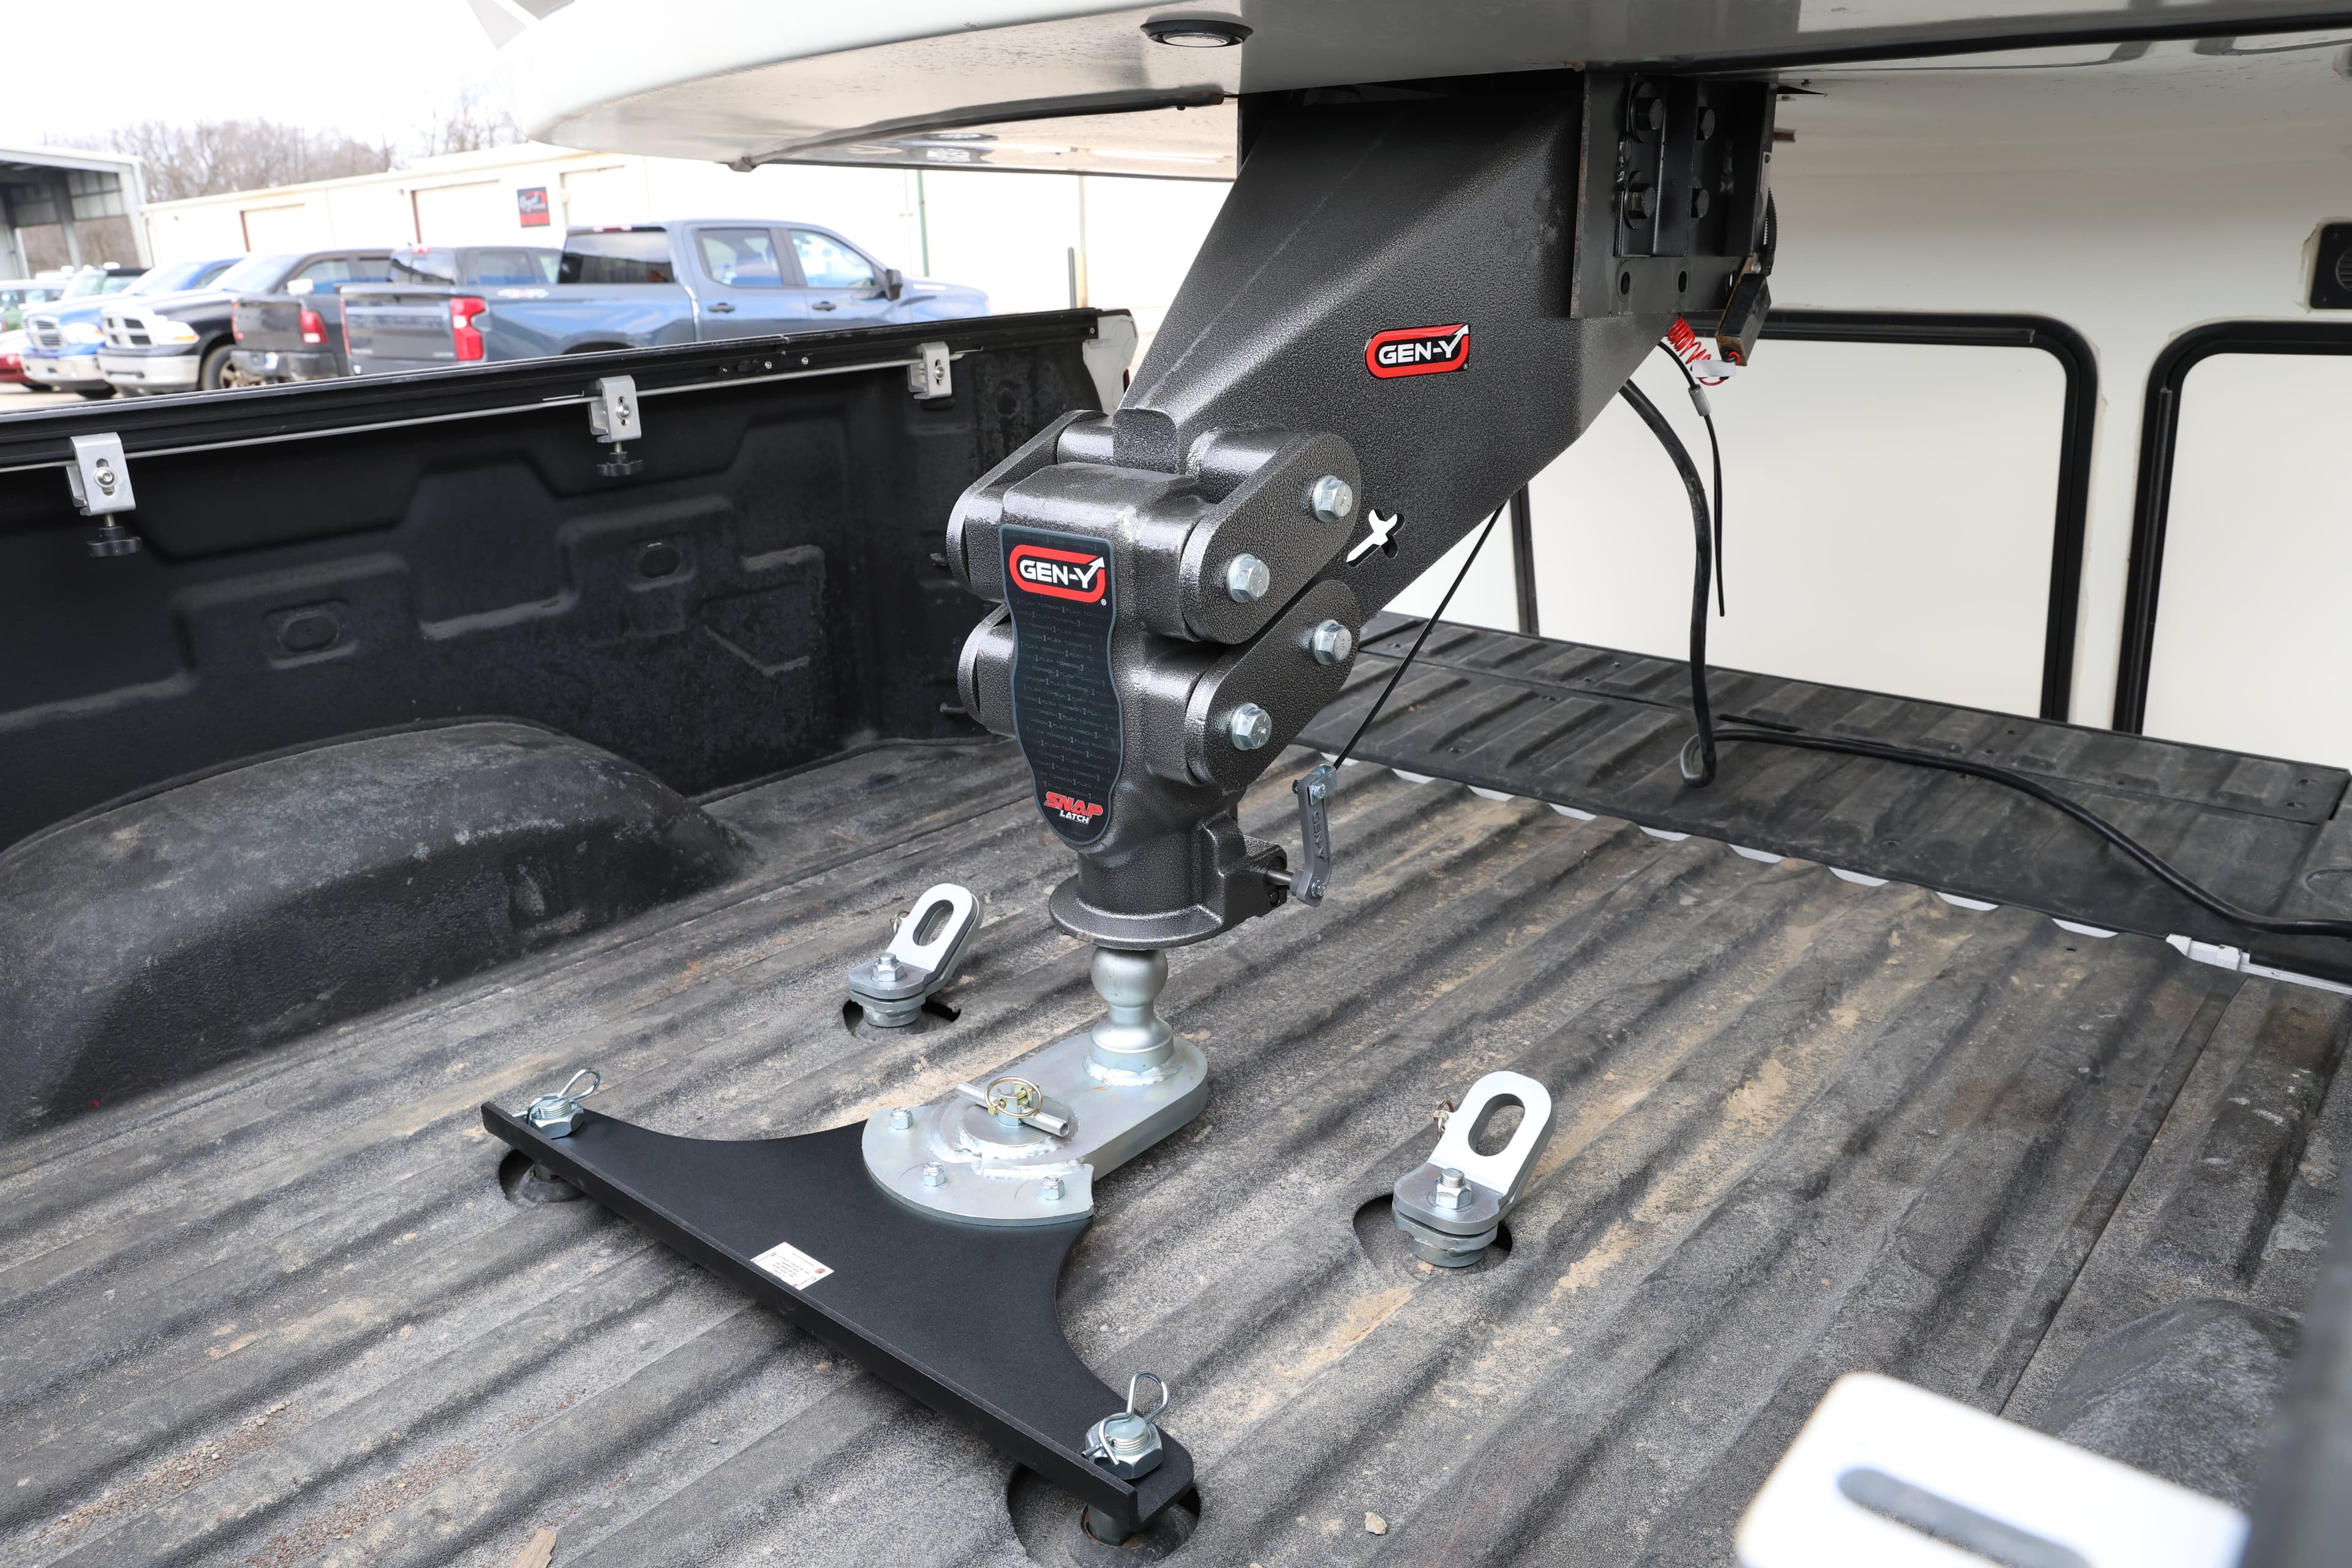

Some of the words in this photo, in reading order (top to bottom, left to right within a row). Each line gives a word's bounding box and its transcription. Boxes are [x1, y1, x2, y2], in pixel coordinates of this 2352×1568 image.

[1379, 326, 1469, 364] GEN-Y
[1020, 557, 1105, 589] GEN-Y
[1044, 791, 1103, 818] SNAP
[1060, 810, 1090, 824] LATCH
